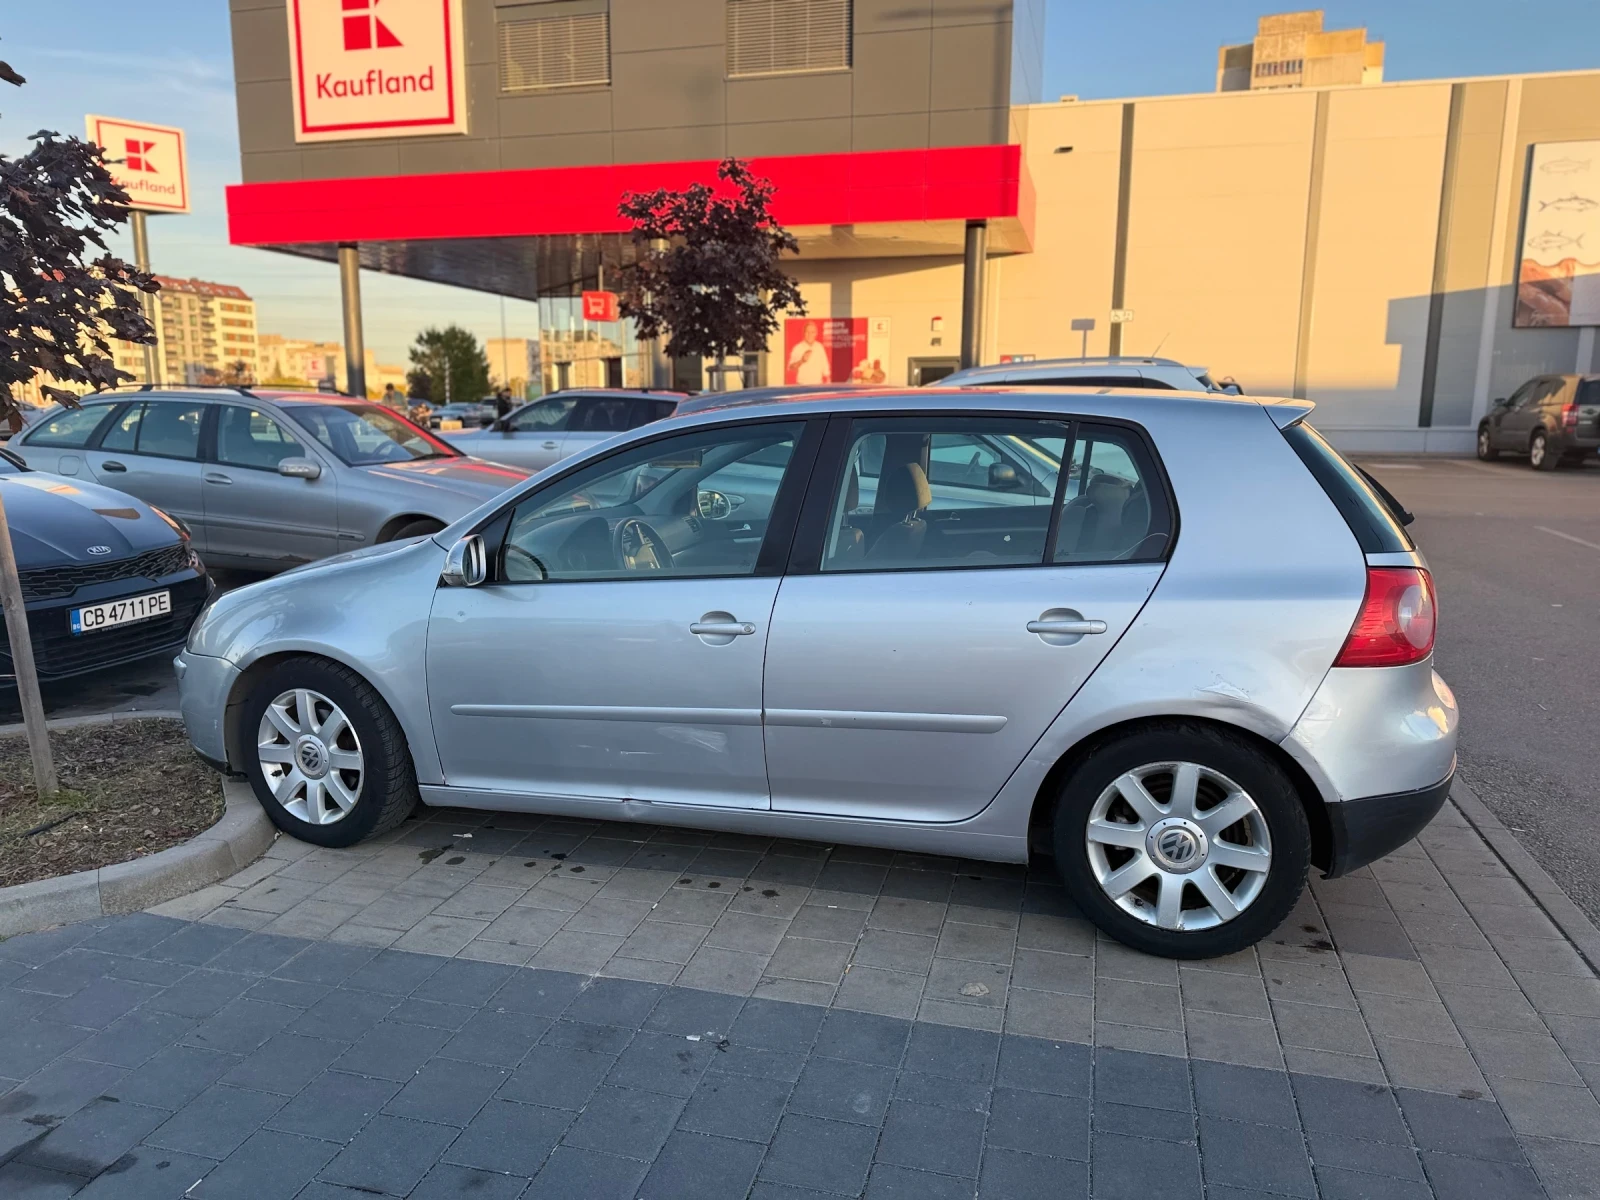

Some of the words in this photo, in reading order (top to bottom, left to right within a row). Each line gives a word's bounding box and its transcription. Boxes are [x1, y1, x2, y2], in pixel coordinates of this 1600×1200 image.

[316, 65, 434, 99] Kaufland
[90, 546, 110, 554] KIA
[83, 608, 105, 627] CB
[109, 599, 145, 621] 4711
[148, 594, 168, 614] PE
